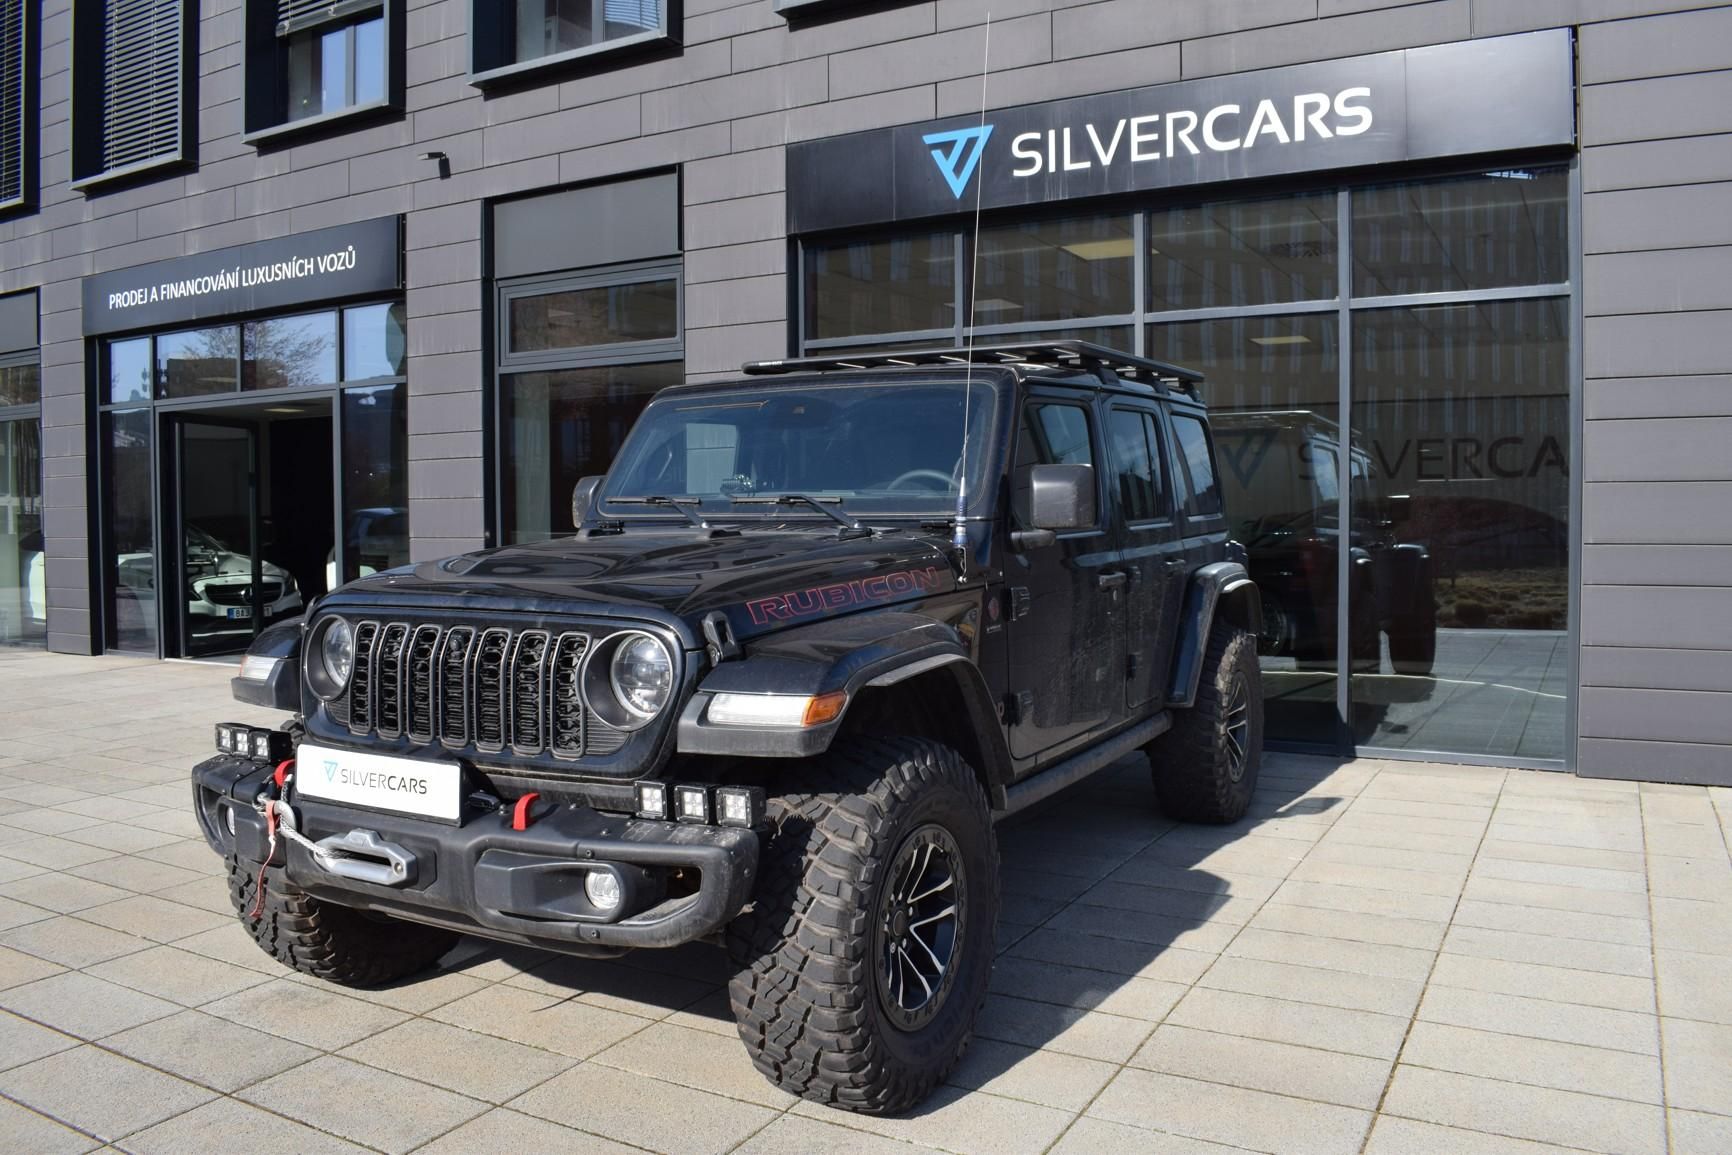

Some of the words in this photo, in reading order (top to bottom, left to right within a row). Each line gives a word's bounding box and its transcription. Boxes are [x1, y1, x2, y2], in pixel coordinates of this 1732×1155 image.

[1011, 87, 1373, 177] SILVERCARS
[108, 287, 147, 309] PRODEJ
[150, 284, 158, 302] A
[160, 267, 239, 301] FINANCOVÁNÍ
[242, 256, 314, 287] LUXUSNÍCH
[317, 245, 356, 273] VOZŮ
[746, 566, 942, 625] RUBICON
[340, 768, 428, 795] SILVERCARS
